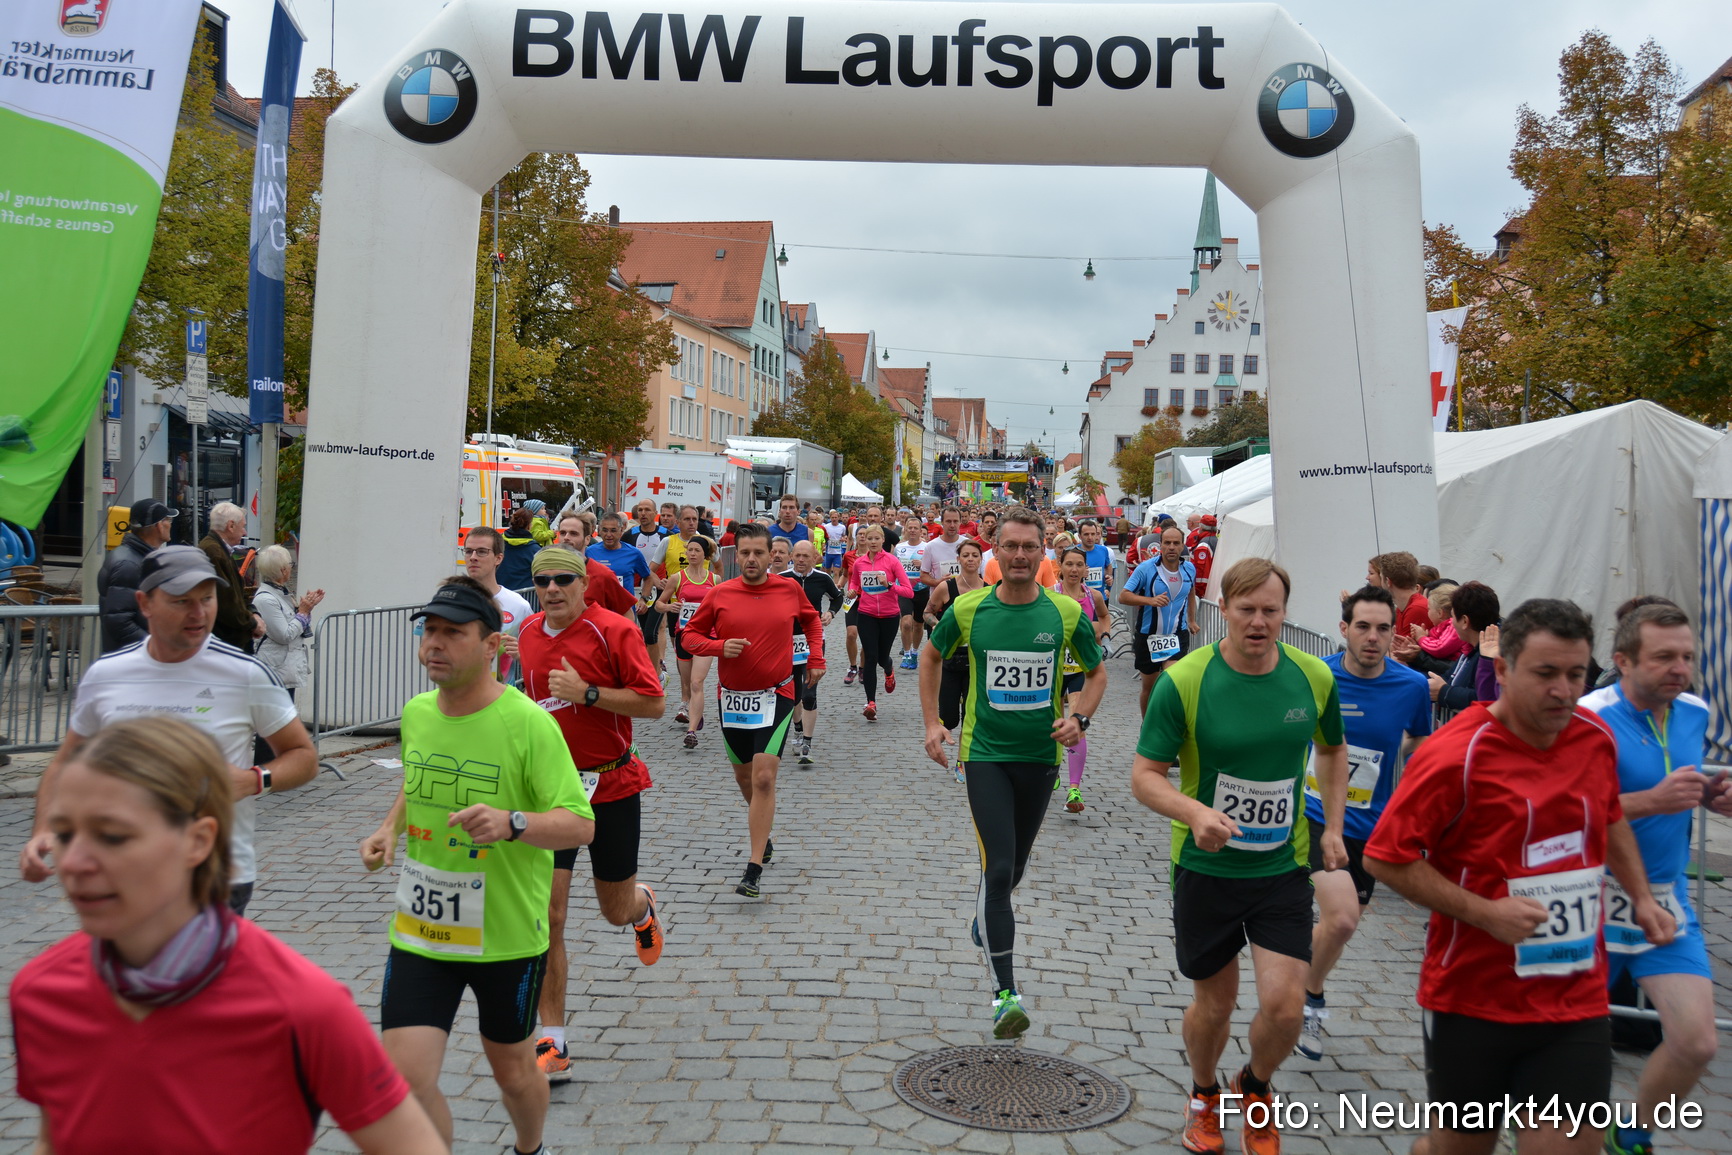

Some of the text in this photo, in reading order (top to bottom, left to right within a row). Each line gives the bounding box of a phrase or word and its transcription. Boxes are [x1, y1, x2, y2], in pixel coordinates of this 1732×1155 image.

[511, 8, 1226, 107] BMW Laufsport
[396, 51, 471, 82] BMW
[1266, 64, 1345, 96] BMW
[191, 319, 203, 348] P
[111, 377, 119, 413] P
[140, 435, 146, 451] 3
[308, 442, 435, 461] www.bmw-laufsport.de
[1299, 461, 1433, 478] www.bmw-laufsport.de
[863, 577, 881, 587] 221
[1085, 572, 1101, 581] 171
[1033, 632, 1055, 642] AOK
[1151, 638, 1177, 651] 2626
[1012, 656, 1044, 664] Neumarkt
[994, 666, 1048, 688] 2315
[545, 700, 562, 709] DEHN
[725, 695, 761, 712] 2605
[1003, 693, 1037, 702] Thomas
[1284, 707, 1308, 720] AOK
[1346, 752, 1371, 762] umarkt
[1219, 781, 1285, 796] PARTL Neumarkt
[1222, 794, 1287, 825] 2368
[402, 865, 467, 889] PARTL Neumarkt
[1512, 879, 1596, 898] PARTL Neumarkt
[411, 884, 461, 922] 351
[1527, 893, 1599, 938] 317
[420, 924, 451, 941] Klaus
